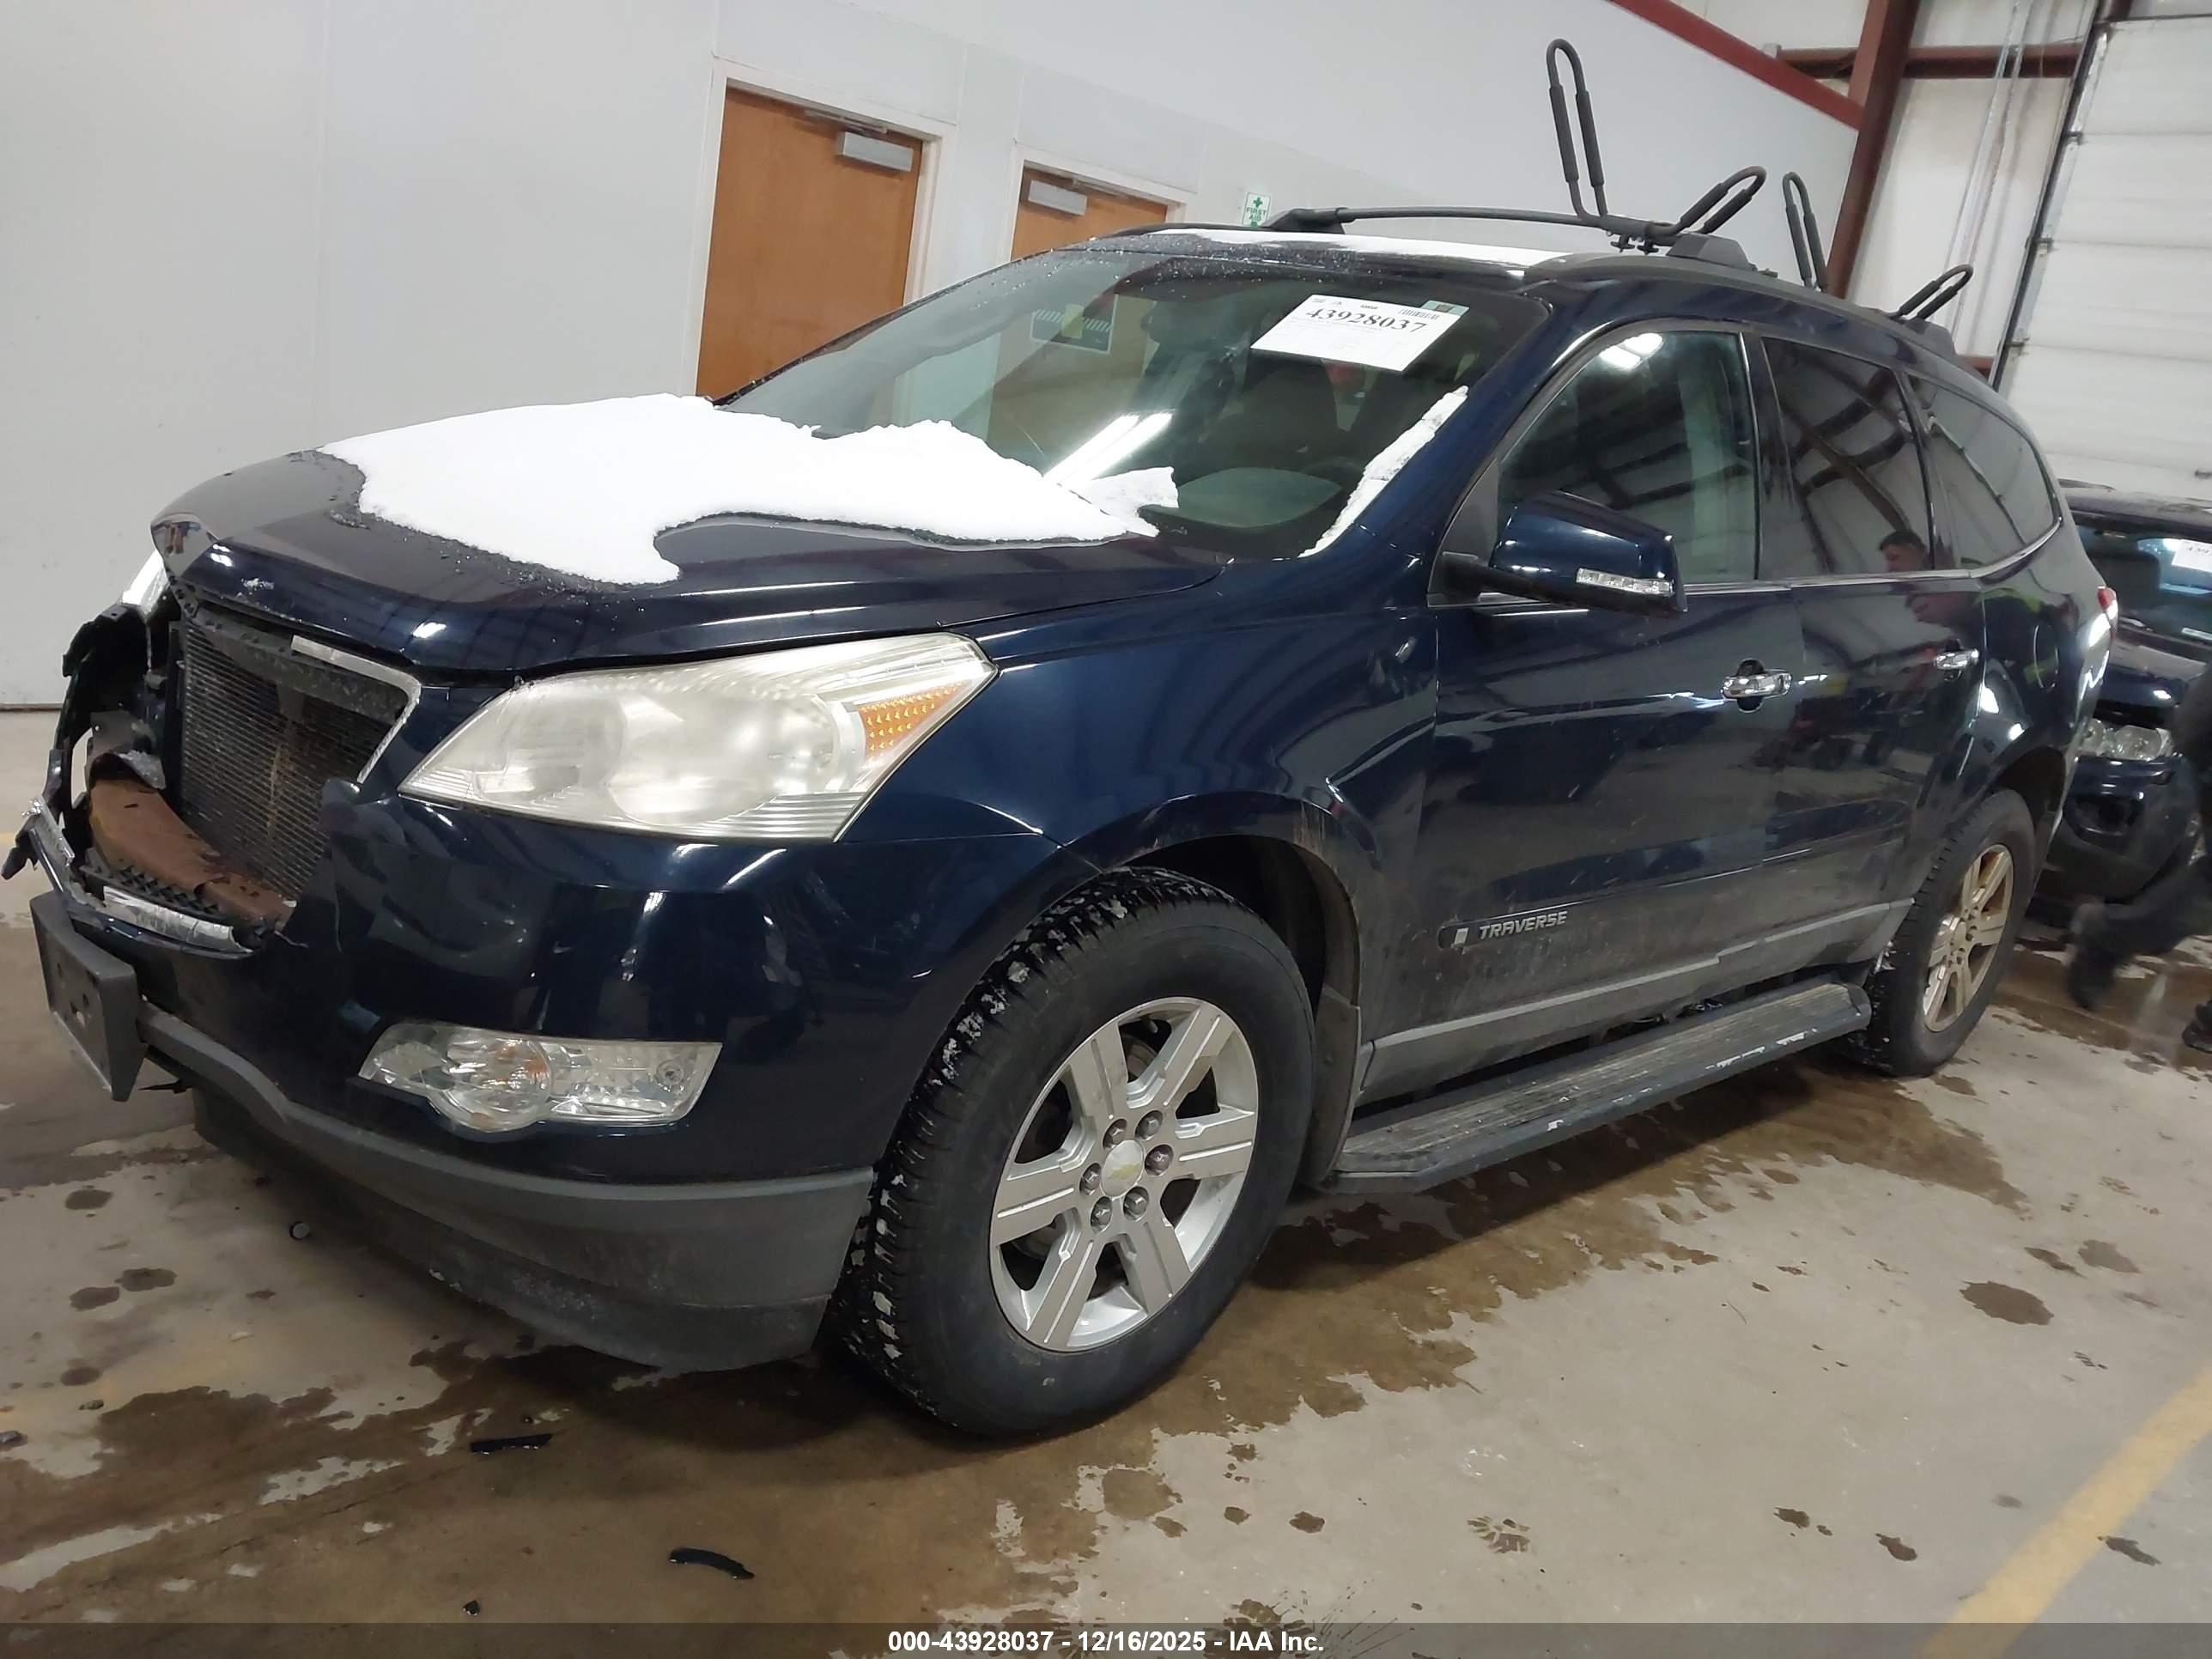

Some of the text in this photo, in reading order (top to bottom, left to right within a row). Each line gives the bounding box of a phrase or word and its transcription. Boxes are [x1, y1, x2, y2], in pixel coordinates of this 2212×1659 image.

[1246, 207, 1267, 216] FIRST
[1306, 307, 1428, 333] 43928037
[1479, 911, 1568, 939] TRAVERSE
